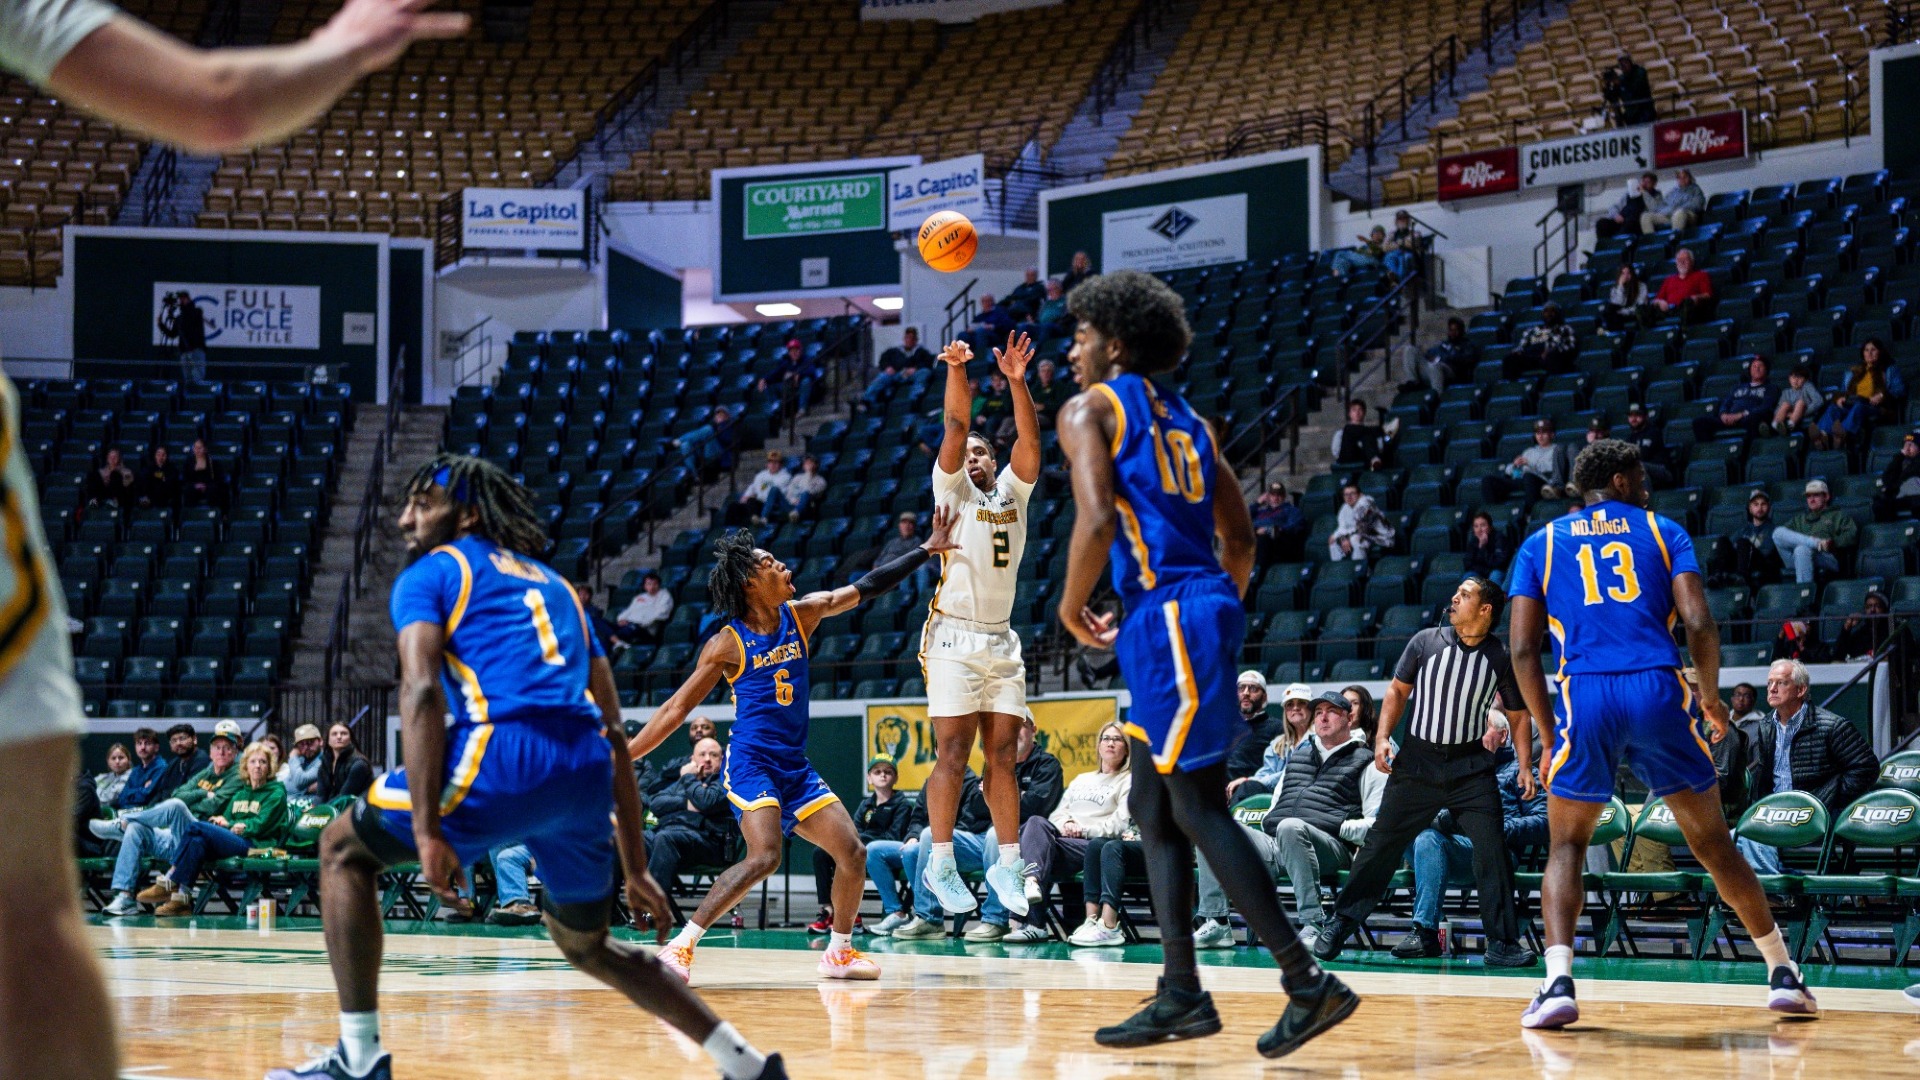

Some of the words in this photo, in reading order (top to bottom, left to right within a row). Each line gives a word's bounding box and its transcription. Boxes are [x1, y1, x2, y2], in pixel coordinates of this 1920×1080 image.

[1530, 135, 1641, 169] CONCESSIONS
[753, 181, 871, 206] COURTYARD
[894, 183, 914, 200] La
[917, 168, 978, 197] Capitol
[469, 201, 494, 218] La
[500, 201, 577, 224] Capitol
[224, 289, 293, 309] FULL
[247, 330, 292, 344] TITLE
[1149, 421, 1205, 504] 10
[993, 531, 1010, 568] 2
[1575, 541, 1642, 606] 13
[522, 588, 566, 666] 1
[773, 668, 794, 706] 6
